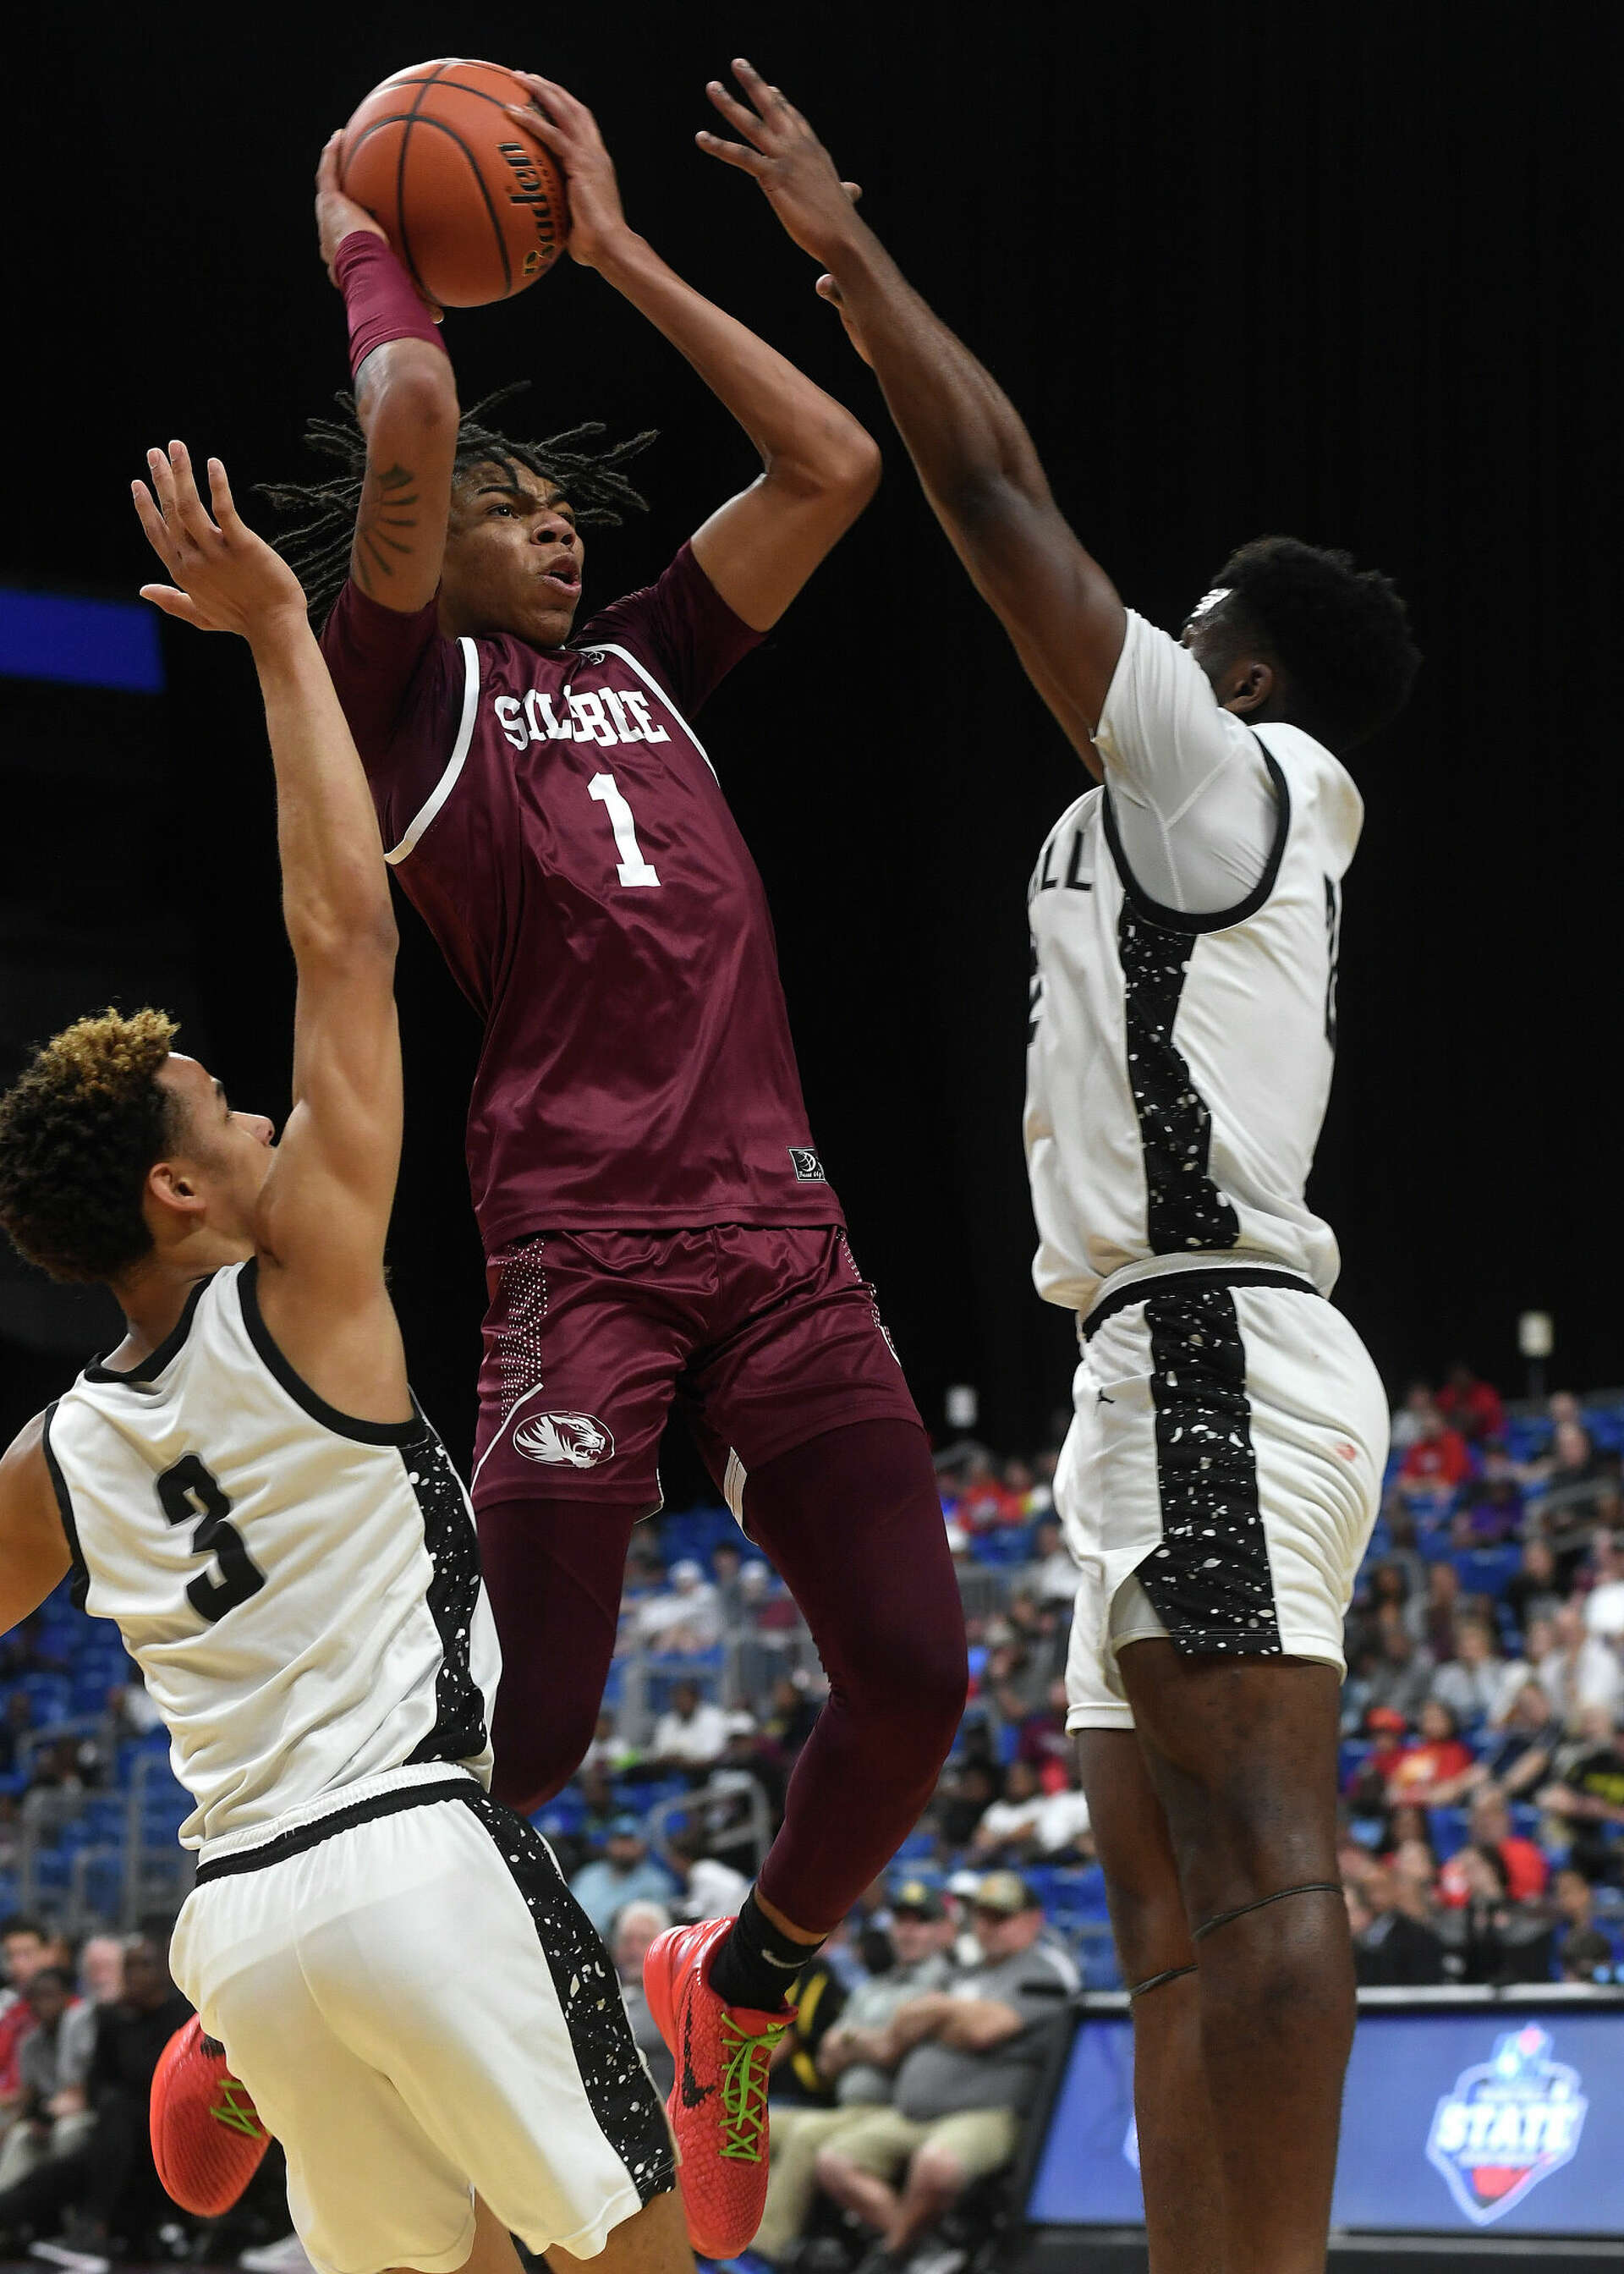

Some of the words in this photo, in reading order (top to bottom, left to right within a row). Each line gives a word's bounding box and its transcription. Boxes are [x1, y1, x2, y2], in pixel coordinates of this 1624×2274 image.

[497, 141, 556, 277] Baden
[494, 684, 672, 750] SILBEE
[587, 771, 661, 887] 1
[1032, 828, 1093, 890] LL
[156, 1454, 265, 1623] 3
[1438, 2103, 1578, 2151] STATE
